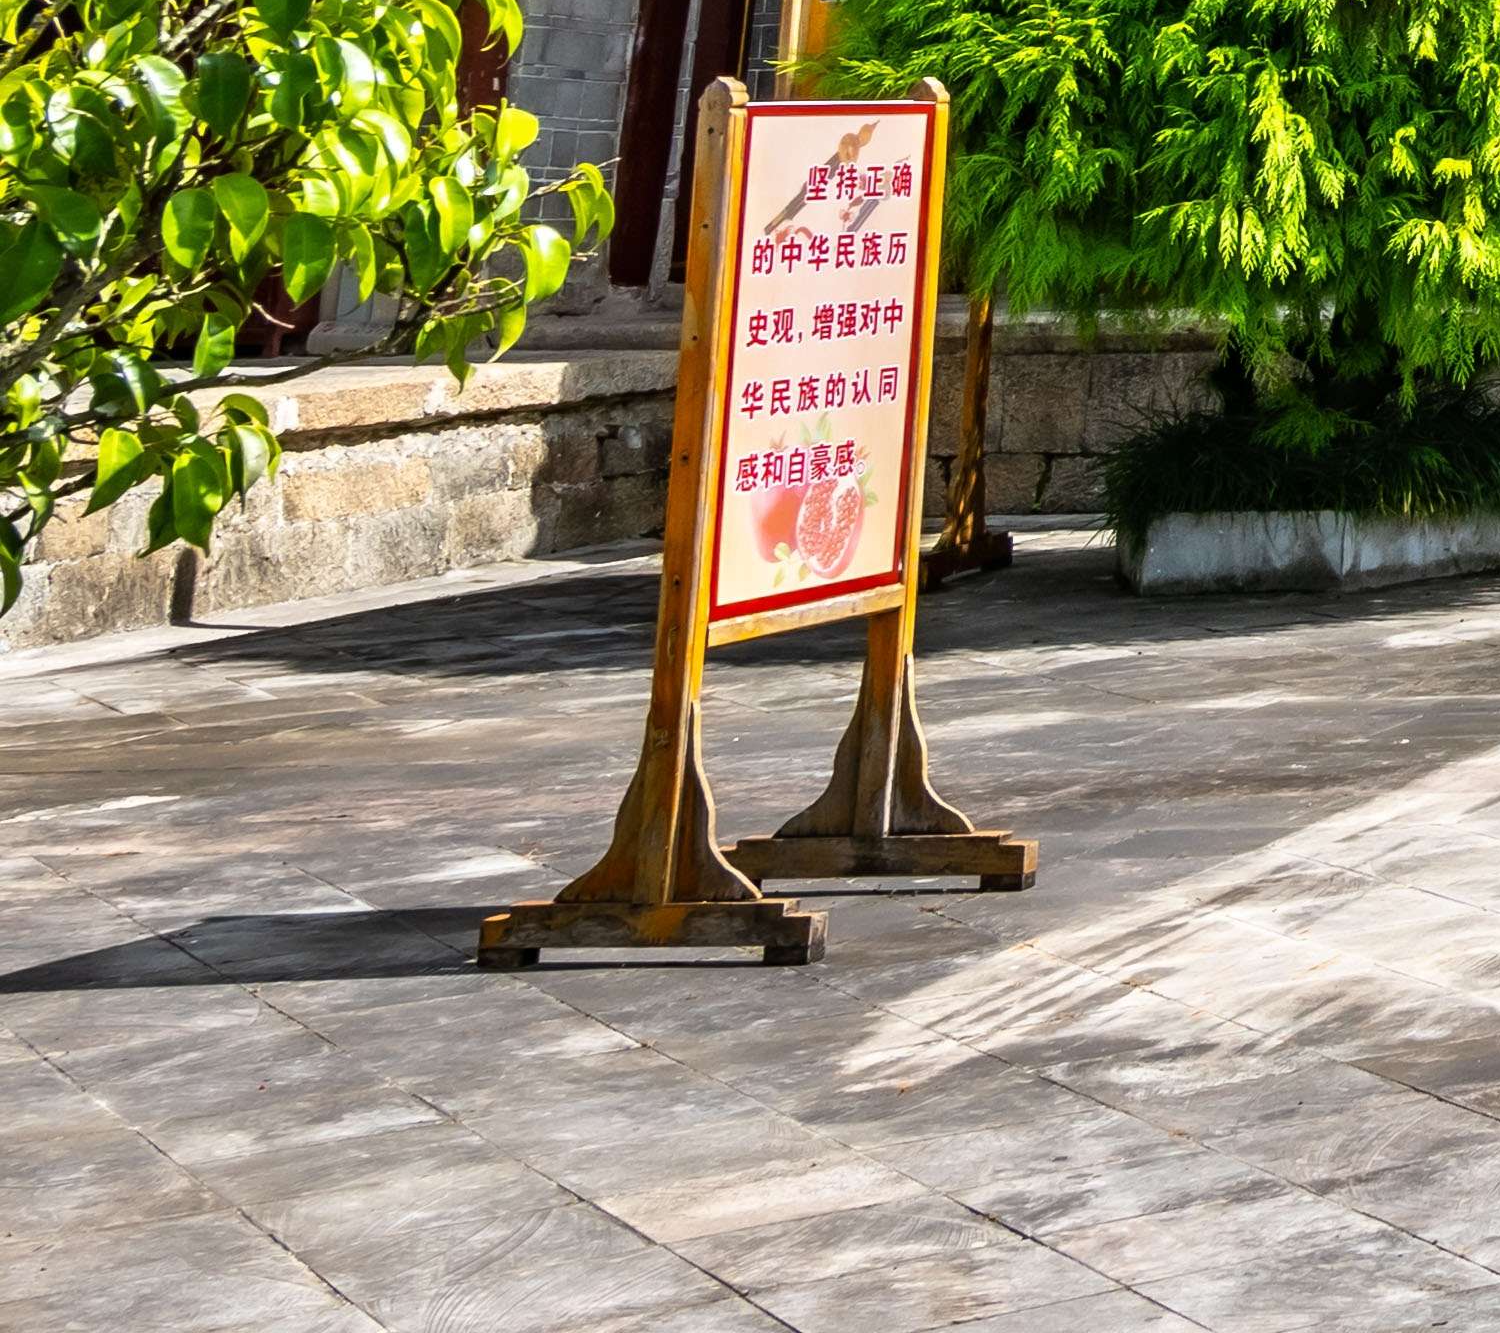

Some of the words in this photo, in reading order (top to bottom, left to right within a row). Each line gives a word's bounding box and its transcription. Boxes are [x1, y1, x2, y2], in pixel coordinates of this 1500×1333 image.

[805, 162, 914, 202] 坚持正确
[752, 230, 908, 275] 的中华民族历
[740, 364, 899, 419] 华民族的认同
